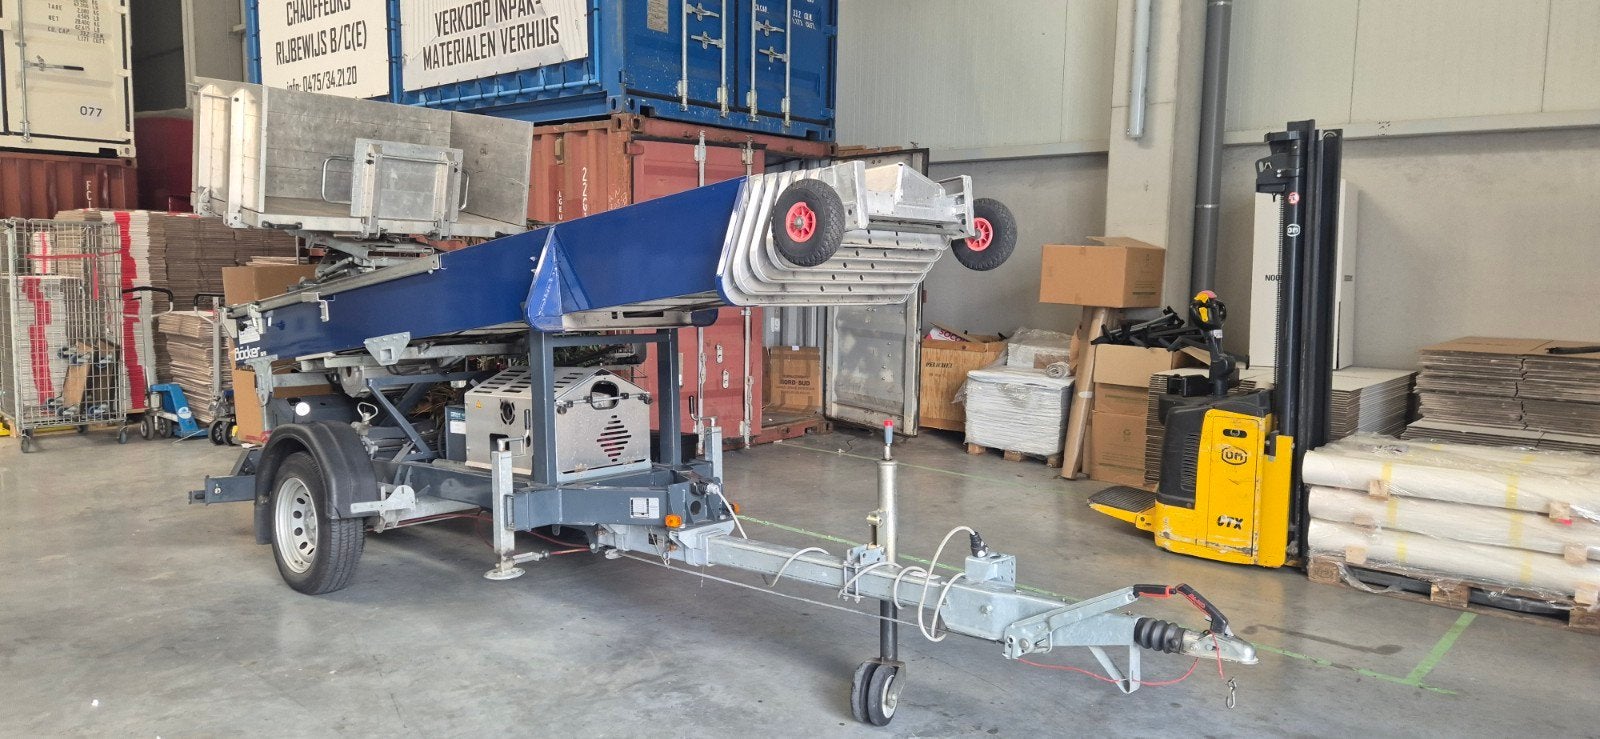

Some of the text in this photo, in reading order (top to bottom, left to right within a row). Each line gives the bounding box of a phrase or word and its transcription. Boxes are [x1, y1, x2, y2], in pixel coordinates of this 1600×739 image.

[435, 0, 541, 37] VERKOOP INPAK-
[276, 20, 367, 66] RIJBEWIJS B/C(E)
[423, 15, 559, 71] MATERIALEN VERHUIS
[80, 105, 103, 117] 077
[235, 346, 260, 361] Böcker
